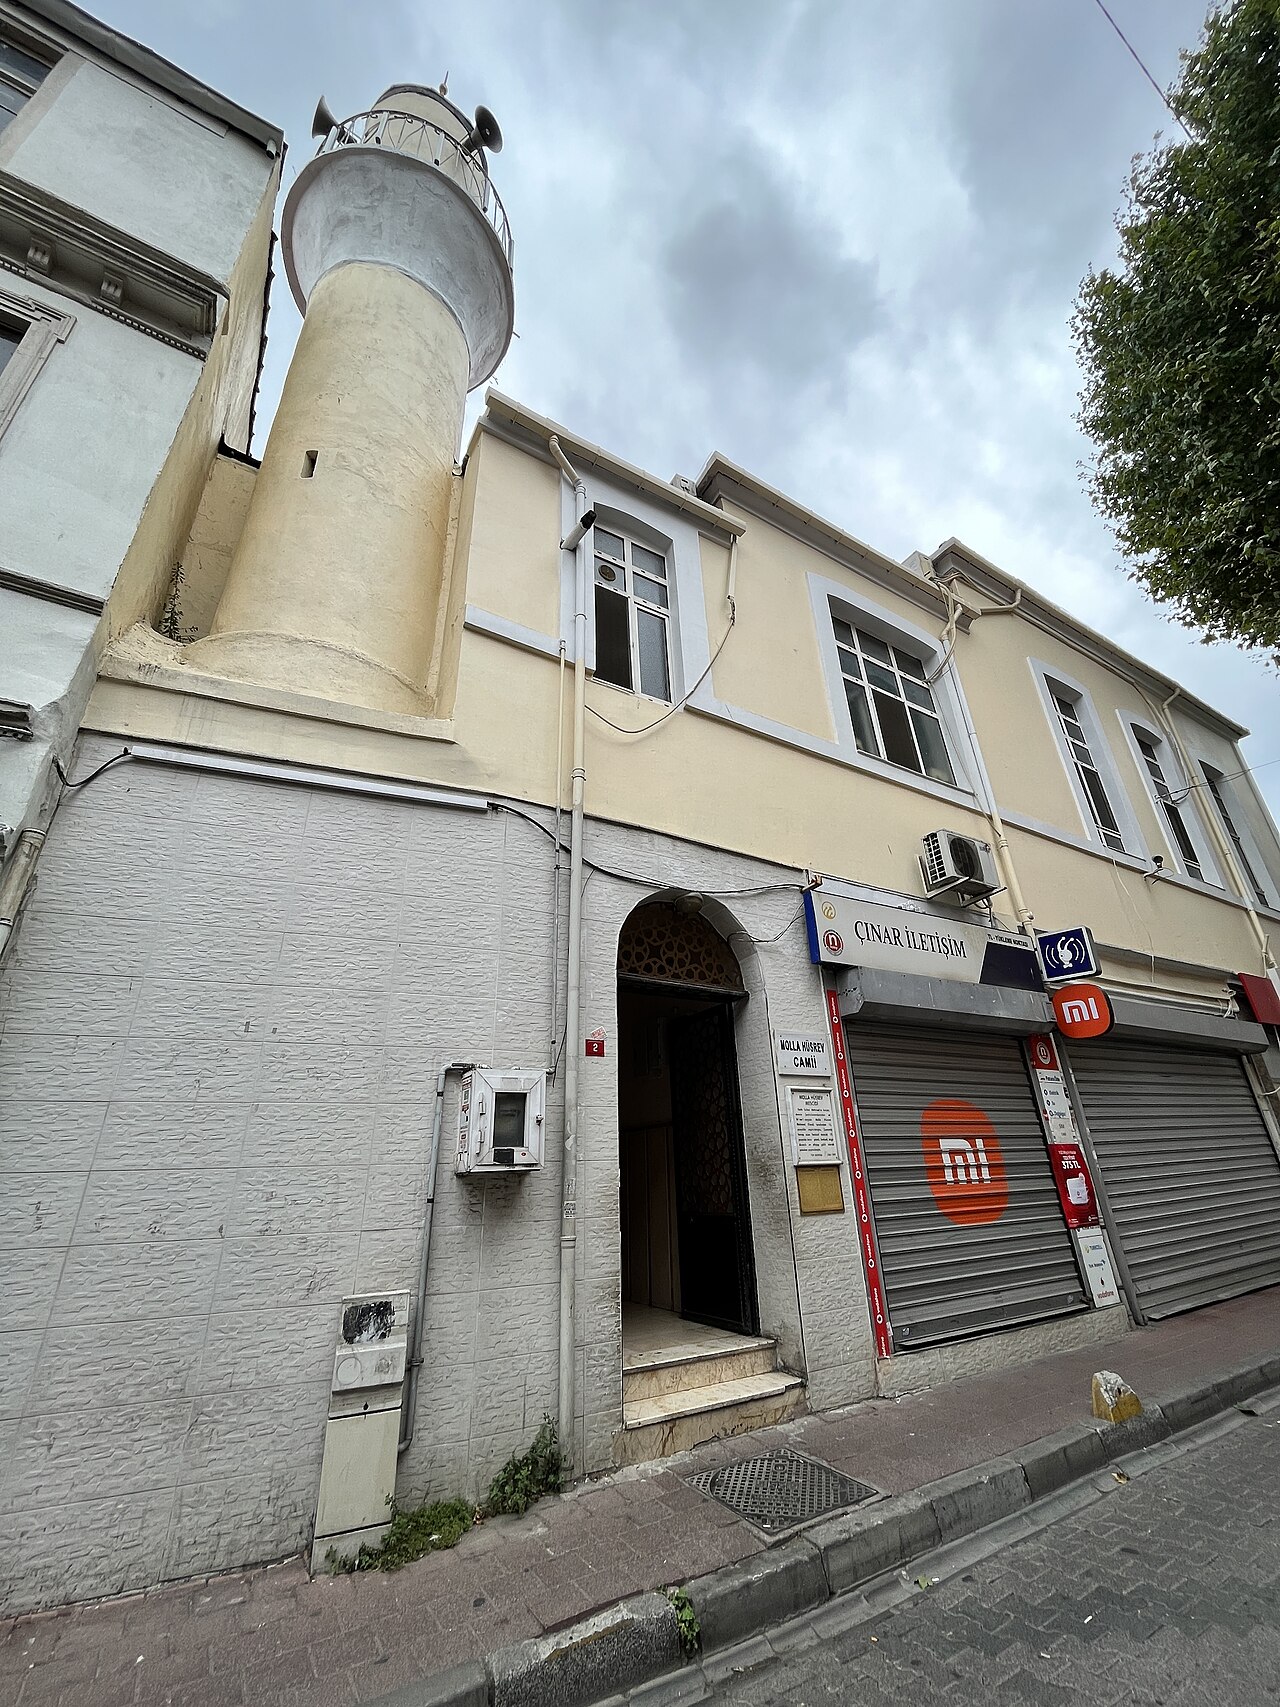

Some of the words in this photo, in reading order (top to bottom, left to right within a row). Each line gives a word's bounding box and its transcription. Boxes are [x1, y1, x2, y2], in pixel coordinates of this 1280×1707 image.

[854, 920, 905, 946] ÇINAR
[904, 925, 968, 961] İLETİŞİM
[593, 1042, 599, 1052] 2
[779, 1039, 801, 1052] MOLLA
